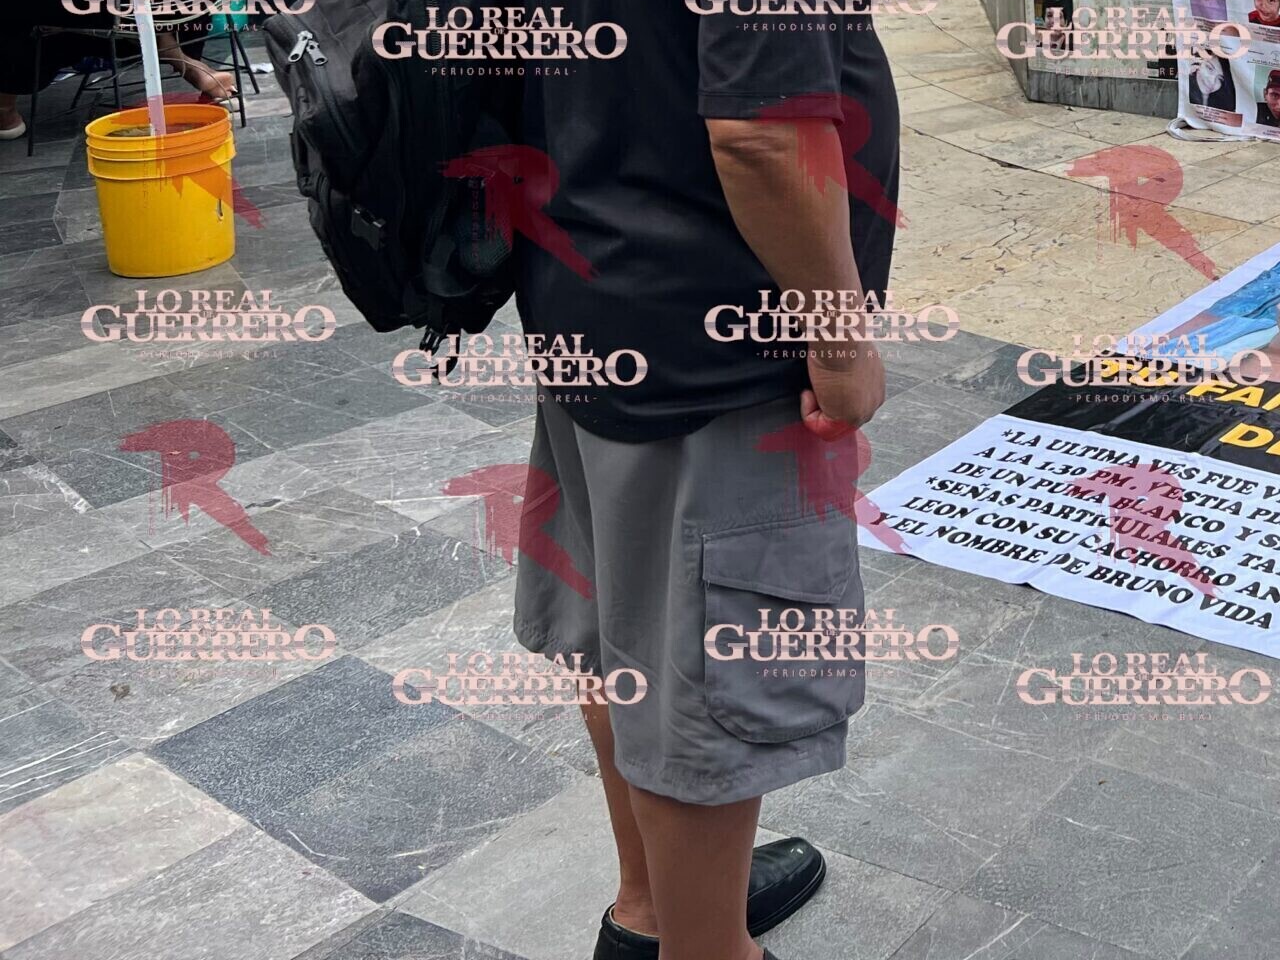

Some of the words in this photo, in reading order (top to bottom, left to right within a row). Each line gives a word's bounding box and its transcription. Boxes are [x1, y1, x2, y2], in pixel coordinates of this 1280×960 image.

[948, 461, 992, 479] DE
[989, 467, 1034, 489] UN
[1030, 477, 1110, 504] PUMA
[1109, 496, 1226, 533] BLANCO
[1235, 525, 1261, 542] Y
[973, 446, 997, 459] A
[997, 451, 1034, 466] LA
[1148, 481, 1244, 517] VESTIA
[1046, 438, 1140, 468] ULTIMA
[1149, 458, 1201, 481] VES
[1198, 471, 1259, 496] FUE
[902, 496, 979, 519] LEON
[975, 512, 1039, 535] CON
[1034, 526, 1081, 545] SU
[1078, 533, 1238, 587] CACHORRO
[1017, 497, 1232, 559] PARTICULARES
[869, 511, 899, 526] Y
[890, 517, 929, 537] EL
[926, 524, 1050, 564] NOMBRE
[1042, 552, 1091, 575] DE
[1083, 565, 1195, 605] BRUNO
[1199, 592, 1274, 630] VIDA
